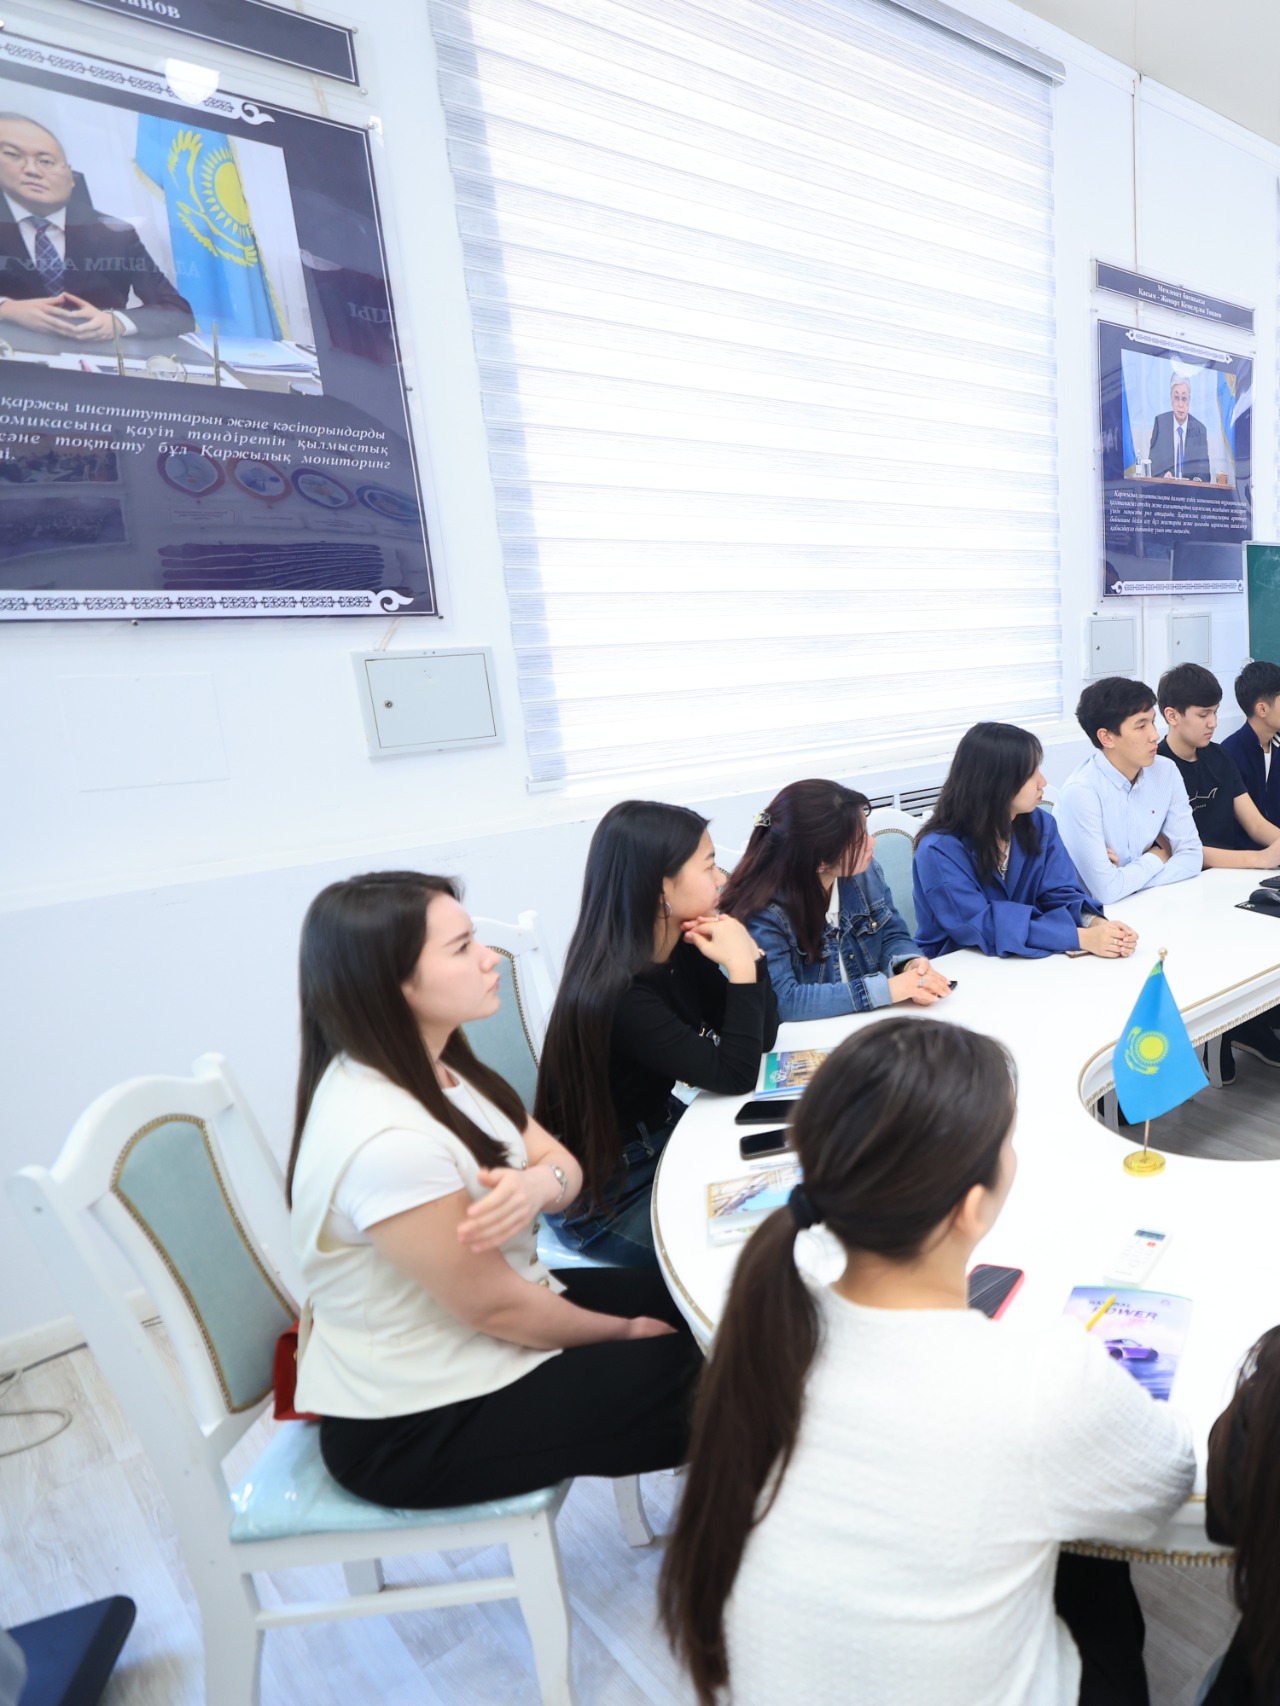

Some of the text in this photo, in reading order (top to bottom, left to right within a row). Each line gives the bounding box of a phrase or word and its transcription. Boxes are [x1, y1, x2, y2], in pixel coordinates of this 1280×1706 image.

[0, 415, 389, 455] омикасына қауіп төндіретін қылмыстық
[1, 397, 385, 440] қаржы институттарын және кәсіпорындарды
[55, 436, 146, 454] тоқтату
[158, 442, 188, 458] бұл
[200, 444, 291, 464] Қаржылық
[301, 455, 391, 470] мониторинг
